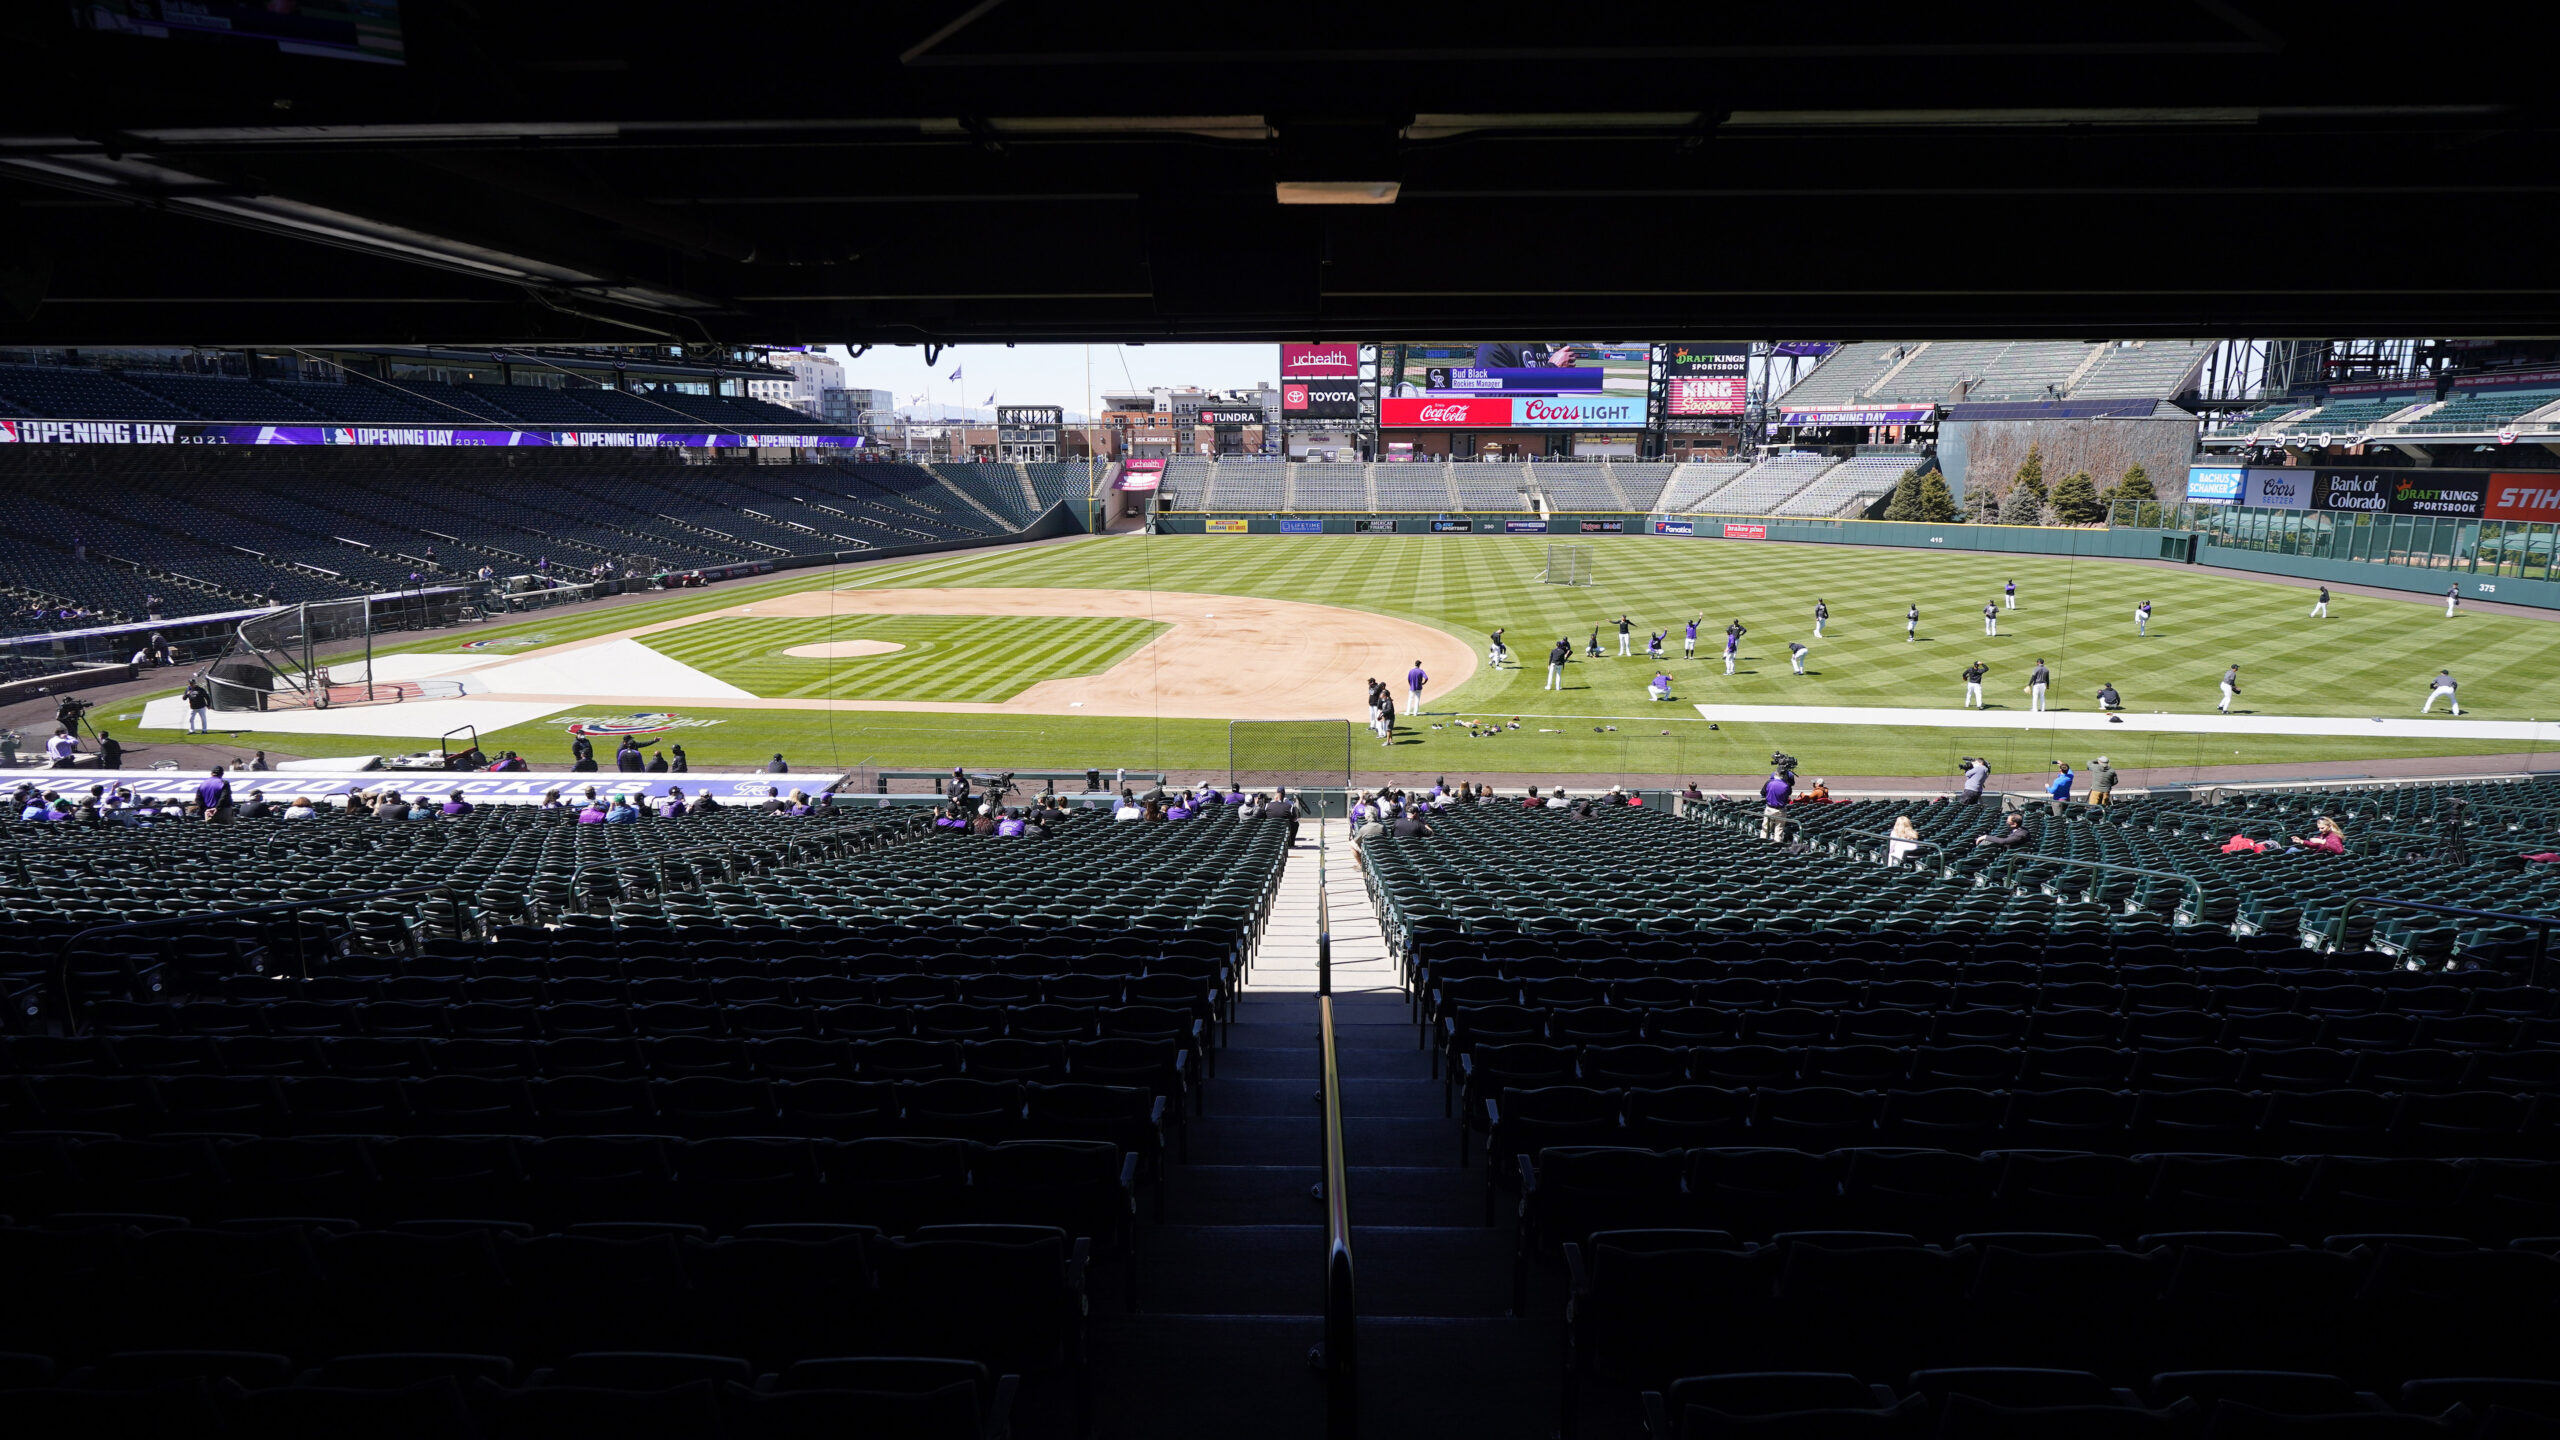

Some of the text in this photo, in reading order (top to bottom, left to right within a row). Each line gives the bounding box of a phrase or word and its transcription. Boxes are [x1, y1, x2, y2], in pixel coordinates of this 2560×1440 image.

[1293, 351, 1347, 366] uchealth
[1676, 355, 1746, 365] DRAFTKINGS
[1452, 368, 1488, 378] Bud Black
[1692, 363, 1745, 371] SPORTSBOOK
[1453, 380, 1501, 389] Rockies Manager
[1682, 381, 1732, 397] KING
[1309, 392, 1356, 402] TOYOTA
[1525, 399, 1630, 420] Coors LIGHT
[1680, 397, 1733, 414] Soopers
[1213, 412, 1256, 422] TUNDRA
[1818, 413, 1864, 425] OPENING
[1865, 413, 1887, 425] DAY
[23, 421, 229, 444] OPENING DAY 2021
[358, 428, 487, 446] OPENING DAY 2021
[580, 432, 634, 447] OPENING
[636, 433, 659, 447] DAY
[760, 434, 800, 448] OPENING
[802, 435, 819, 448] DAY
[2199, 473, 2230, 483] BACHUS
[2330, 474, 2379, 492] Bank of
[2188, 483, 2228, 493] SCHANKER
[2263, 478, 2296, 496] Coors
[2262, 496, 2294, 505] SELTZER
[2329, 492, 2386, 510] Colorado
[2397, 488, 2479, 501] DRAFTKINGS
[2496, 487, 2560, 509] STIH
[2413, 501, 2476, 513] SPORTSBOOK
[1665, 525, 1692, 534] Fanatics
[2479, 583, 2496, 593] 375
[362, 780, 653, 794] ROCKIES
